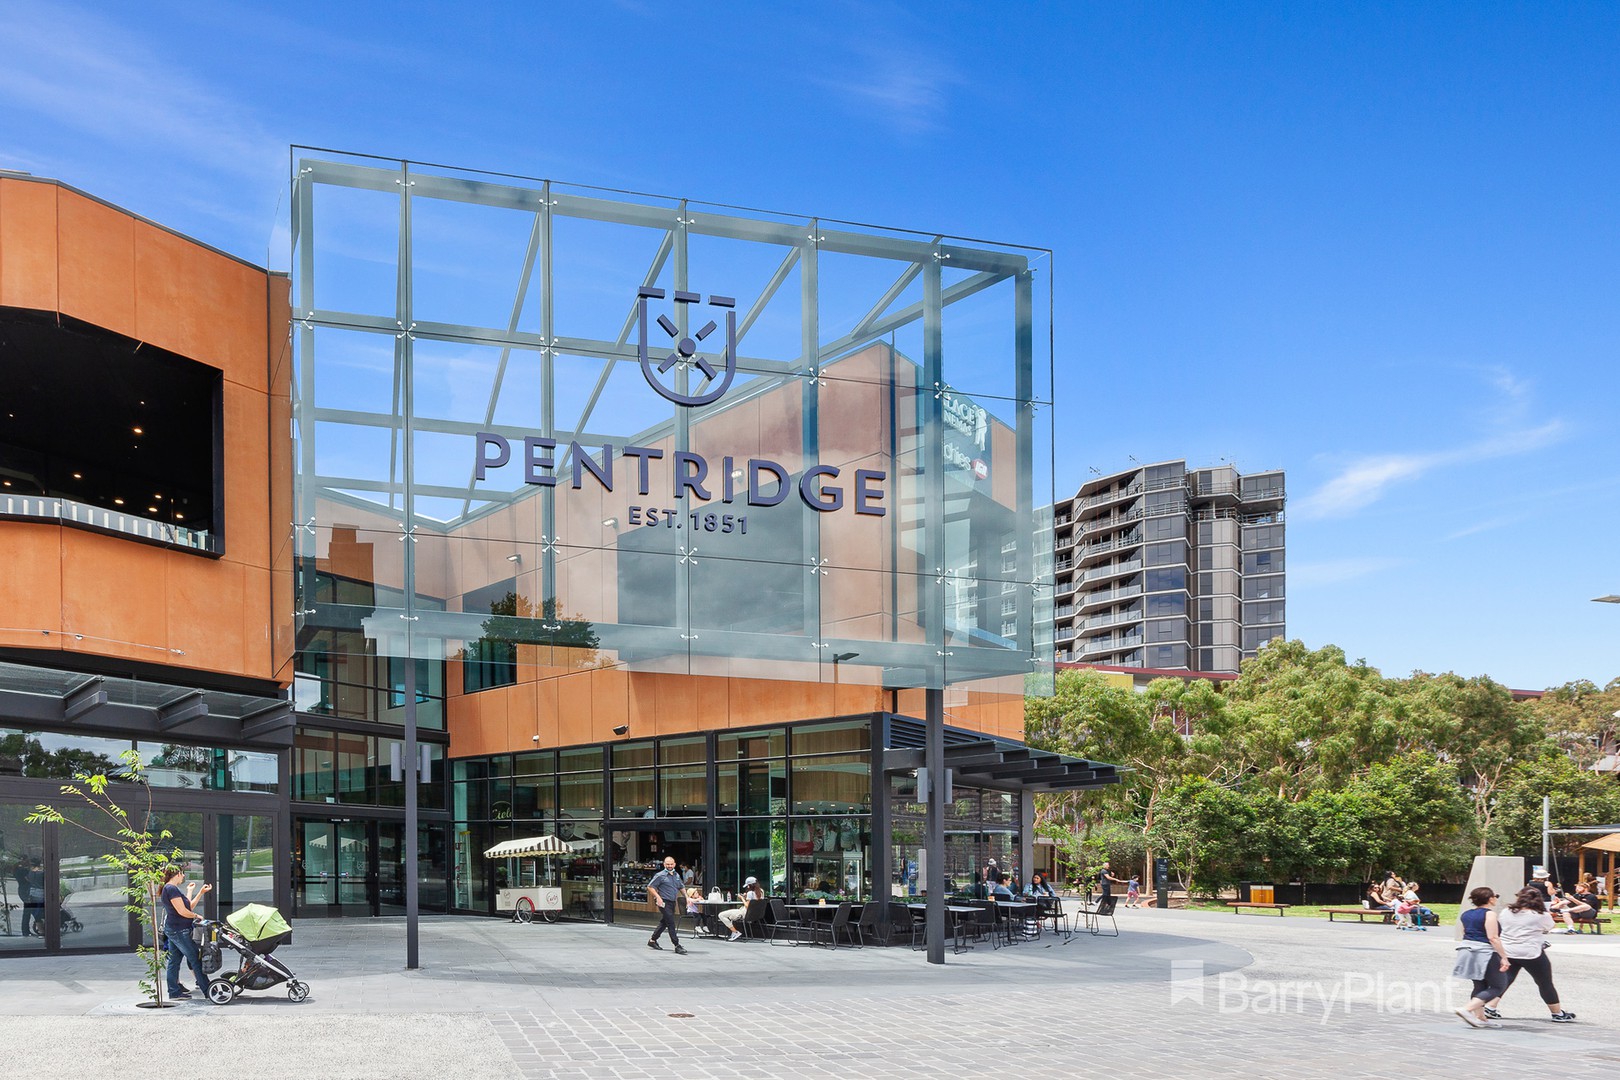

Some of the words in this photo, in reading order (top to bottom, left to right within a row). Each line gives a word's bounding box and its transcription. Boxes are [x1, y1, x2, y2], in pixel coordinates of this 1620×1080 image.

[943, 399, 975, 425] LACE
[475, 432, 887, 517] PENTRIDGE
[628, 506, 682, 529] EST.
[690, 512, 748, 535] 1851
